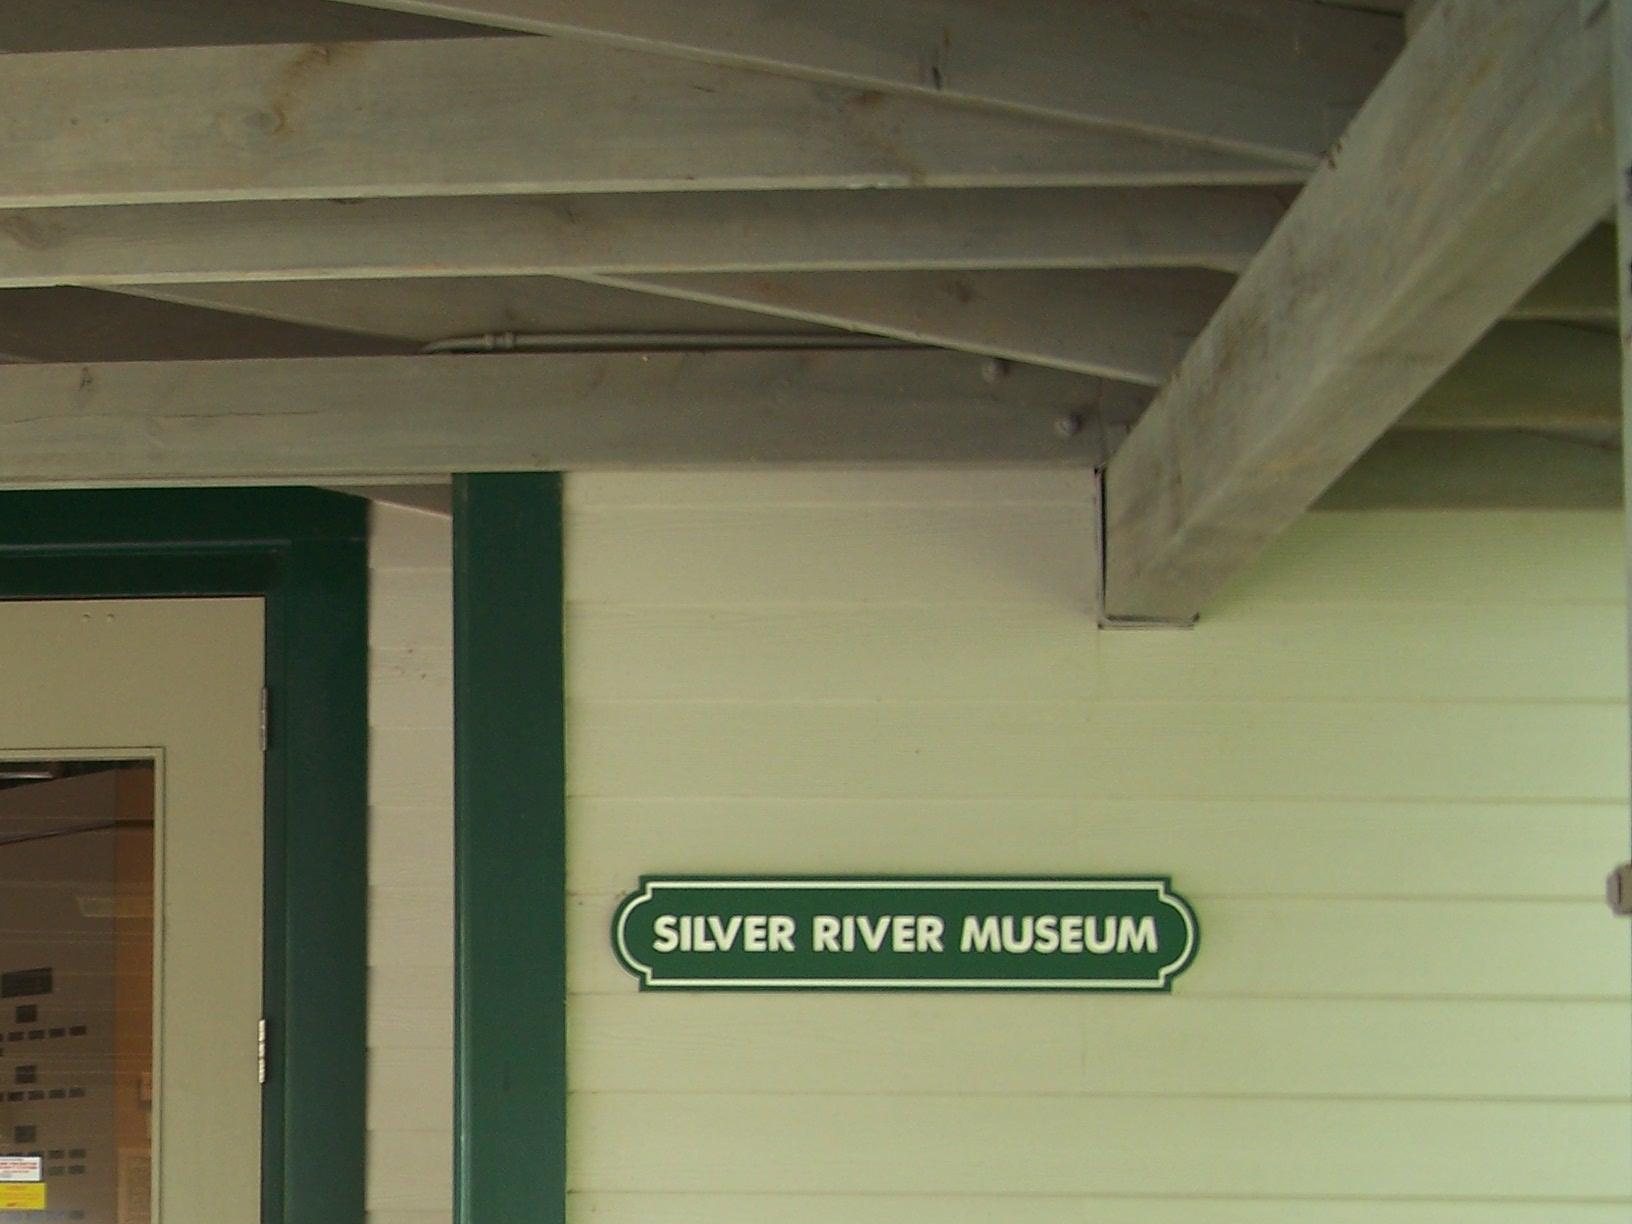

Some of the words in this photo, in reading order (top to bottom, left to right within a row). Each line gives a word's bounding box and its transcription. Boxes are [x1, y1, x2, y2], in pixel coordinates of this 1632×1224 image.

[652, 915, 796, 953] SILVER
[812, 915, 945, 953] RIVER
[960, 915, 1159, 953] MUSEUM
